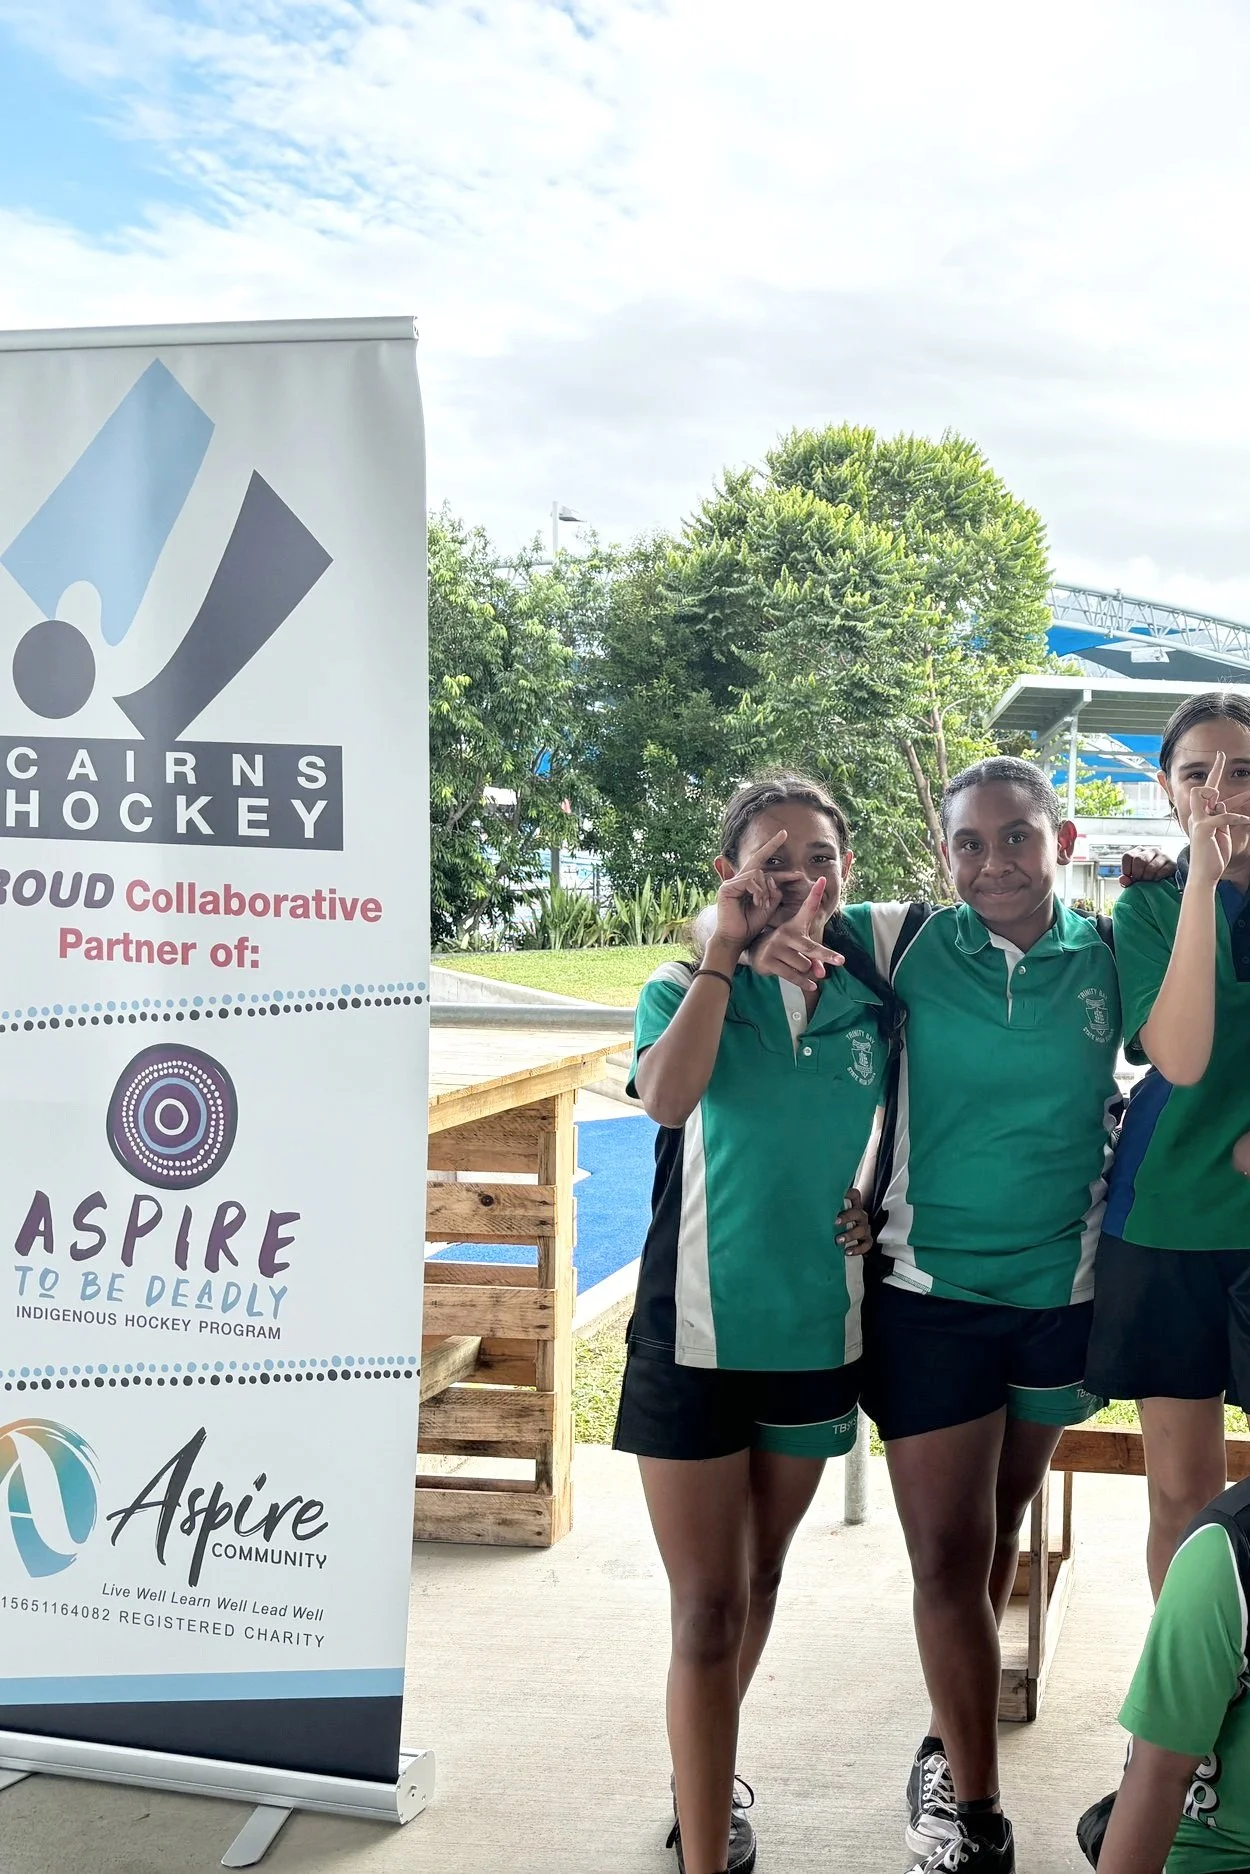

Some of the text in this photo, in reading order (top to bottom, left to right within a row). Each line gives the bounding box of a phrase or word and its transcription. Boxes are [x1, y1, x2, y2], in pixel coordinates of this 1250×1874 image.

[7, 747, 327, 789] CAIRNS
[6, 789, 327, 838] HOCKEY
[126, 880, 382, 922] Collaborative
[60, 928, 259, 968] Partner of:
[15, 1190, 300, 1278] ASPIRE
[15, 1265, 287, 1319] TO BE DEADLY
[17, 1306, 280, 1339] INDIGENOUS HOCKEY PROGRAM
[106, 1427, 328, 1587] Aspire
[212, 1543, 326, 1569] COMMUNITY
[2, 1597, 324, 1647] 15651164082 REGISTERED CHARITY
[103, 1583, 323, 1621] Live Well Learn Well Lead Well
